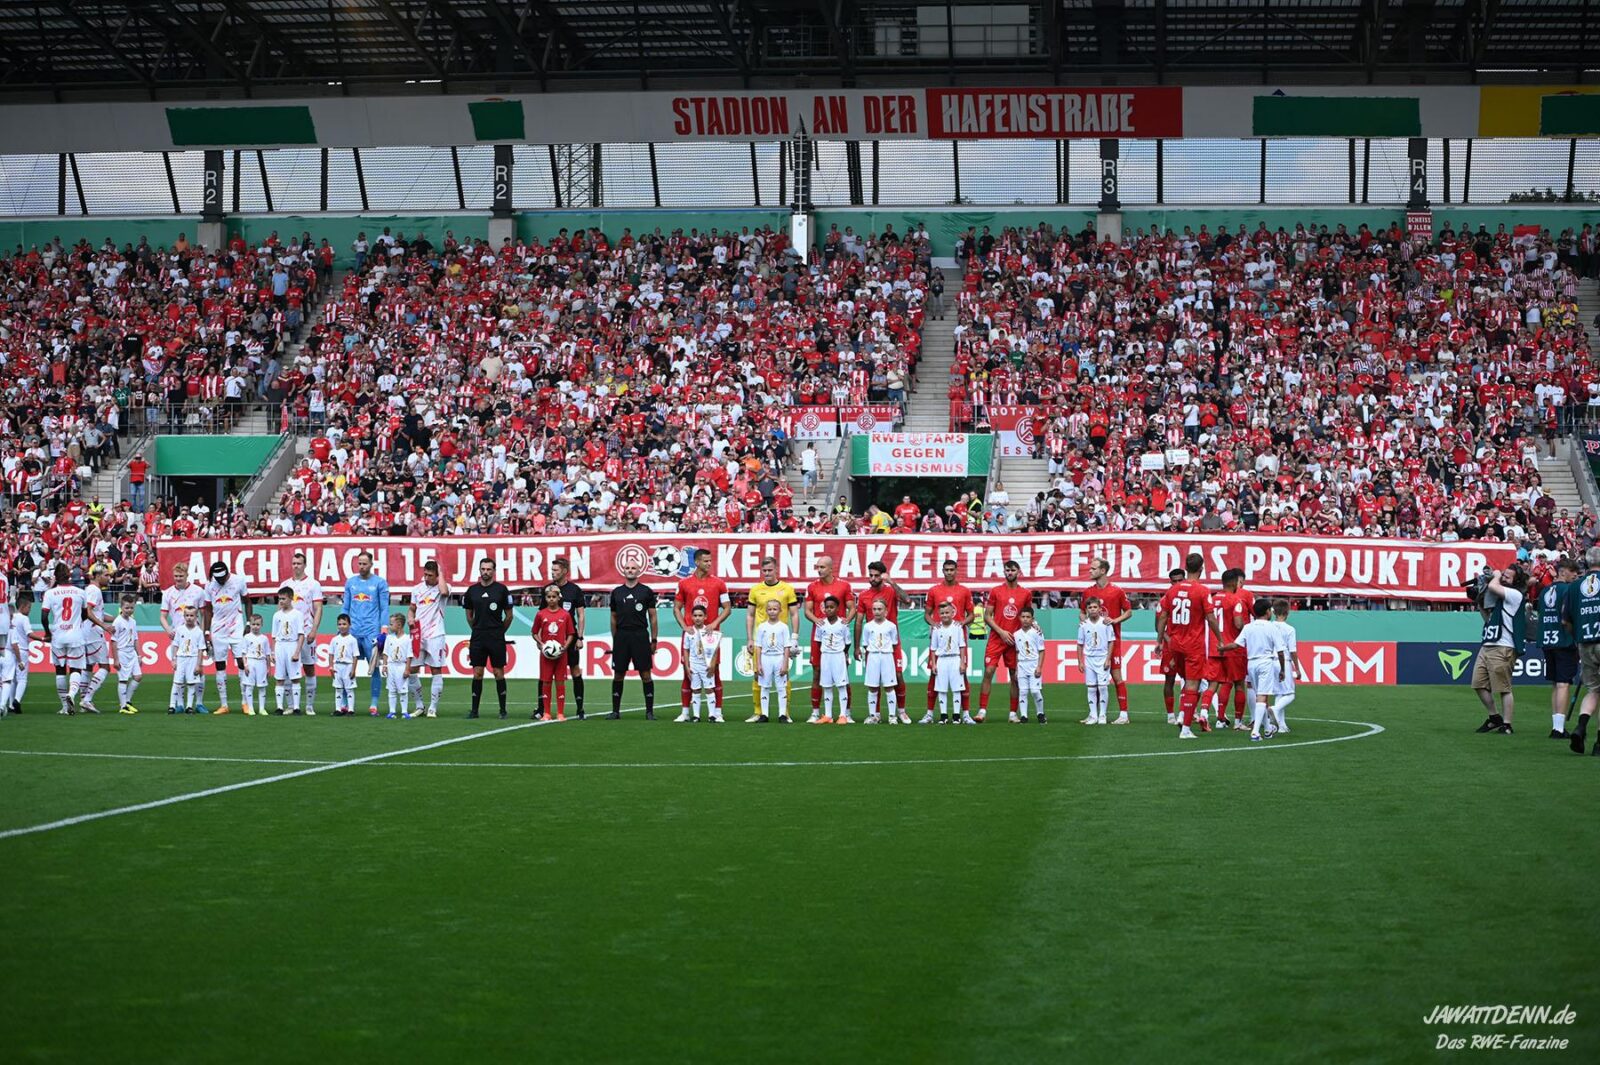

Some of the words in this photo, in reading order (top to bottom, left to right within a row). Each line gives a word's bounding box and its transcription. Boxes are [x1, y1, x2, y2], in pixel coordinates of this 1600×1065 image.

[672, 96, 788, 136] STADION
[813, 95, 847, 135] AN
[864, 95, 918, 134] DER
[496, 165, 508, 182] R
[1102, 159, 1115, 176] R
[1412, 158, 1425, 175] R
[205, 170, 217, 186] R
[1103, 178, 1115, 195] 3
[1413, 178, 1424, 194] 4
[205, 189, 216, 204] 2
[496, 184, 507, 200] 2
[872, 433, 904, 443] RWE
[925, 433, 965, 443] FANS
[892, 448, 945, 458] GEGEN
[873, 462, 964, 473] RASSISMUS
[452, 546, 591, 582] JAHREN
[838, 543, 1056, 578] AKZEPTANZ
[1070, 543, 1143, 579] FÜR
[1245, 546, 1424, 587] PRODUKT
[61, 597, 73, 622] 8
[1172, 597, 1191, 625] 26
[1542, 630, 1560, 644] 53
